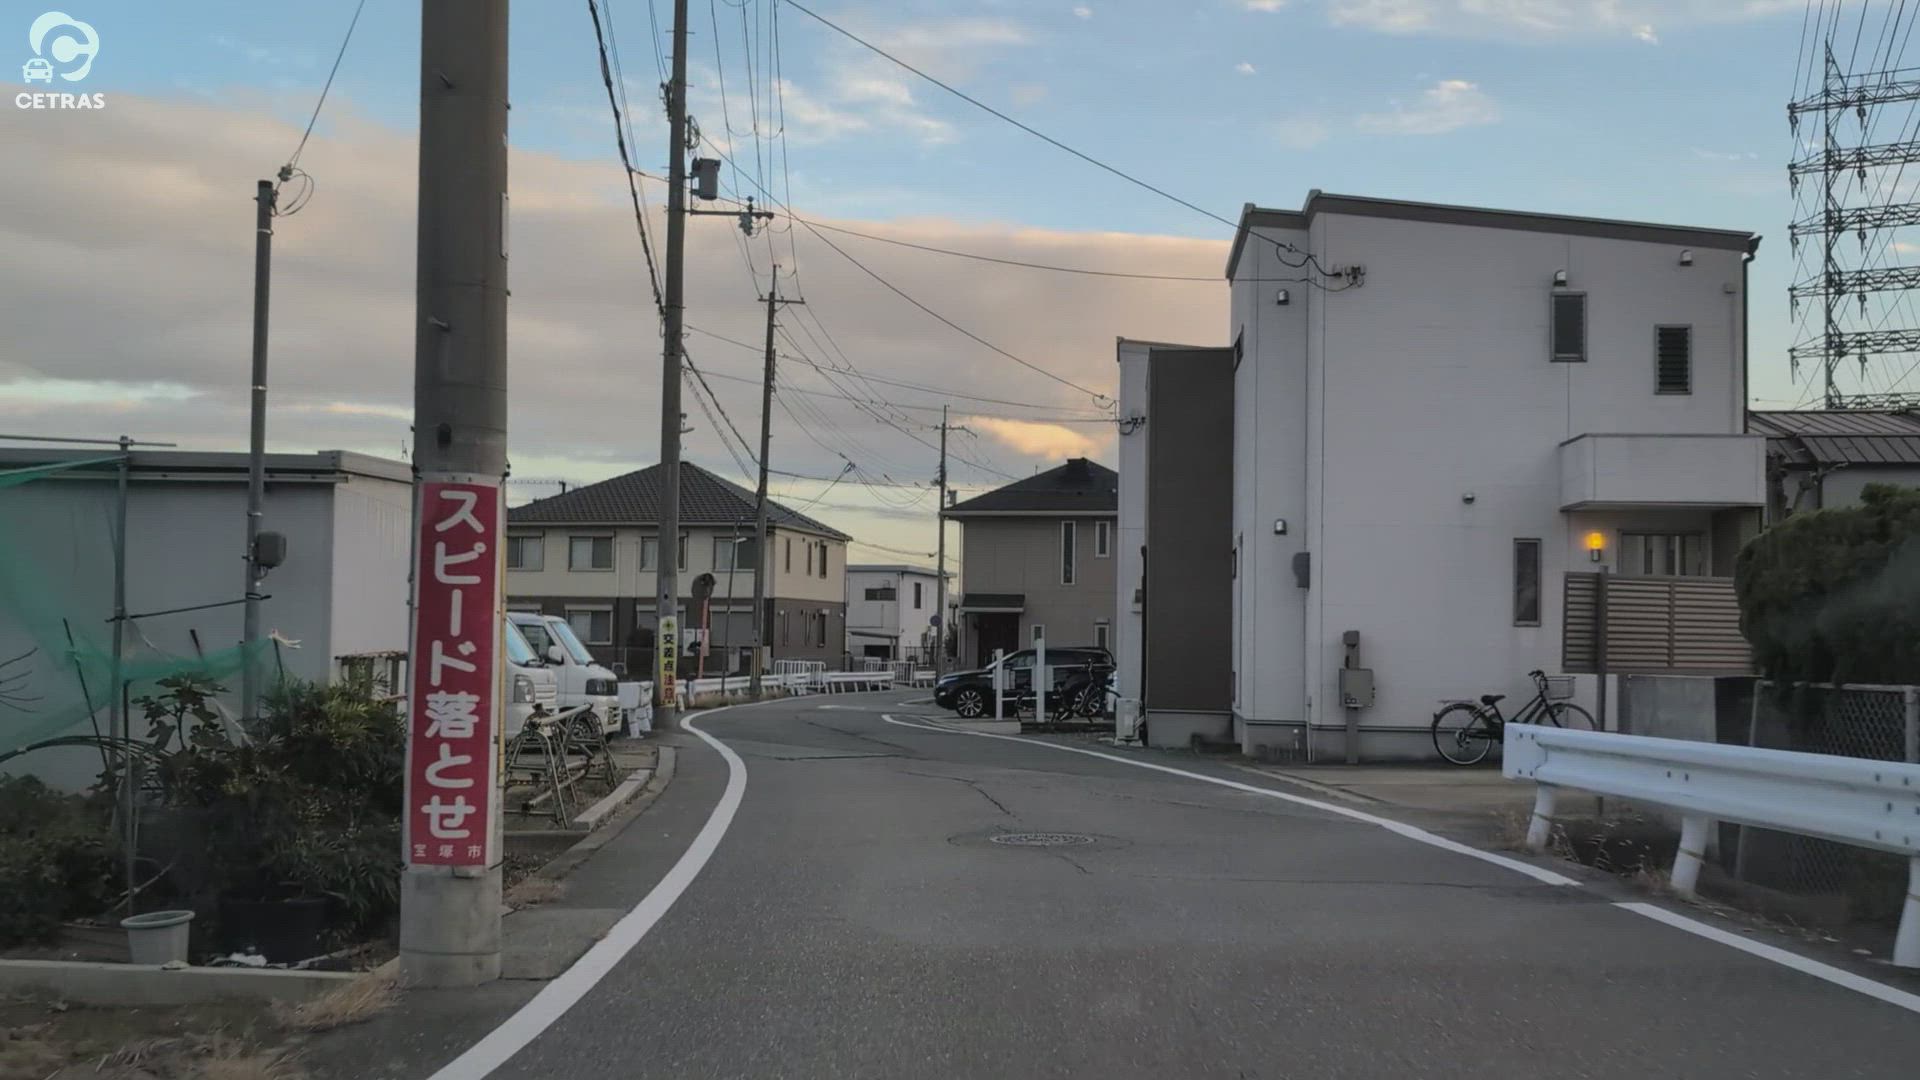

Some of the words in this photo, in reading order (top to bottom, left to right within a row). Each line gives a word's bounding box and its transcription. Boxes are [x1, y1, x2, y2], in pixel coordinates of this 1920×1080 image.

[420, 489, 487, 839] スピード落とせ
